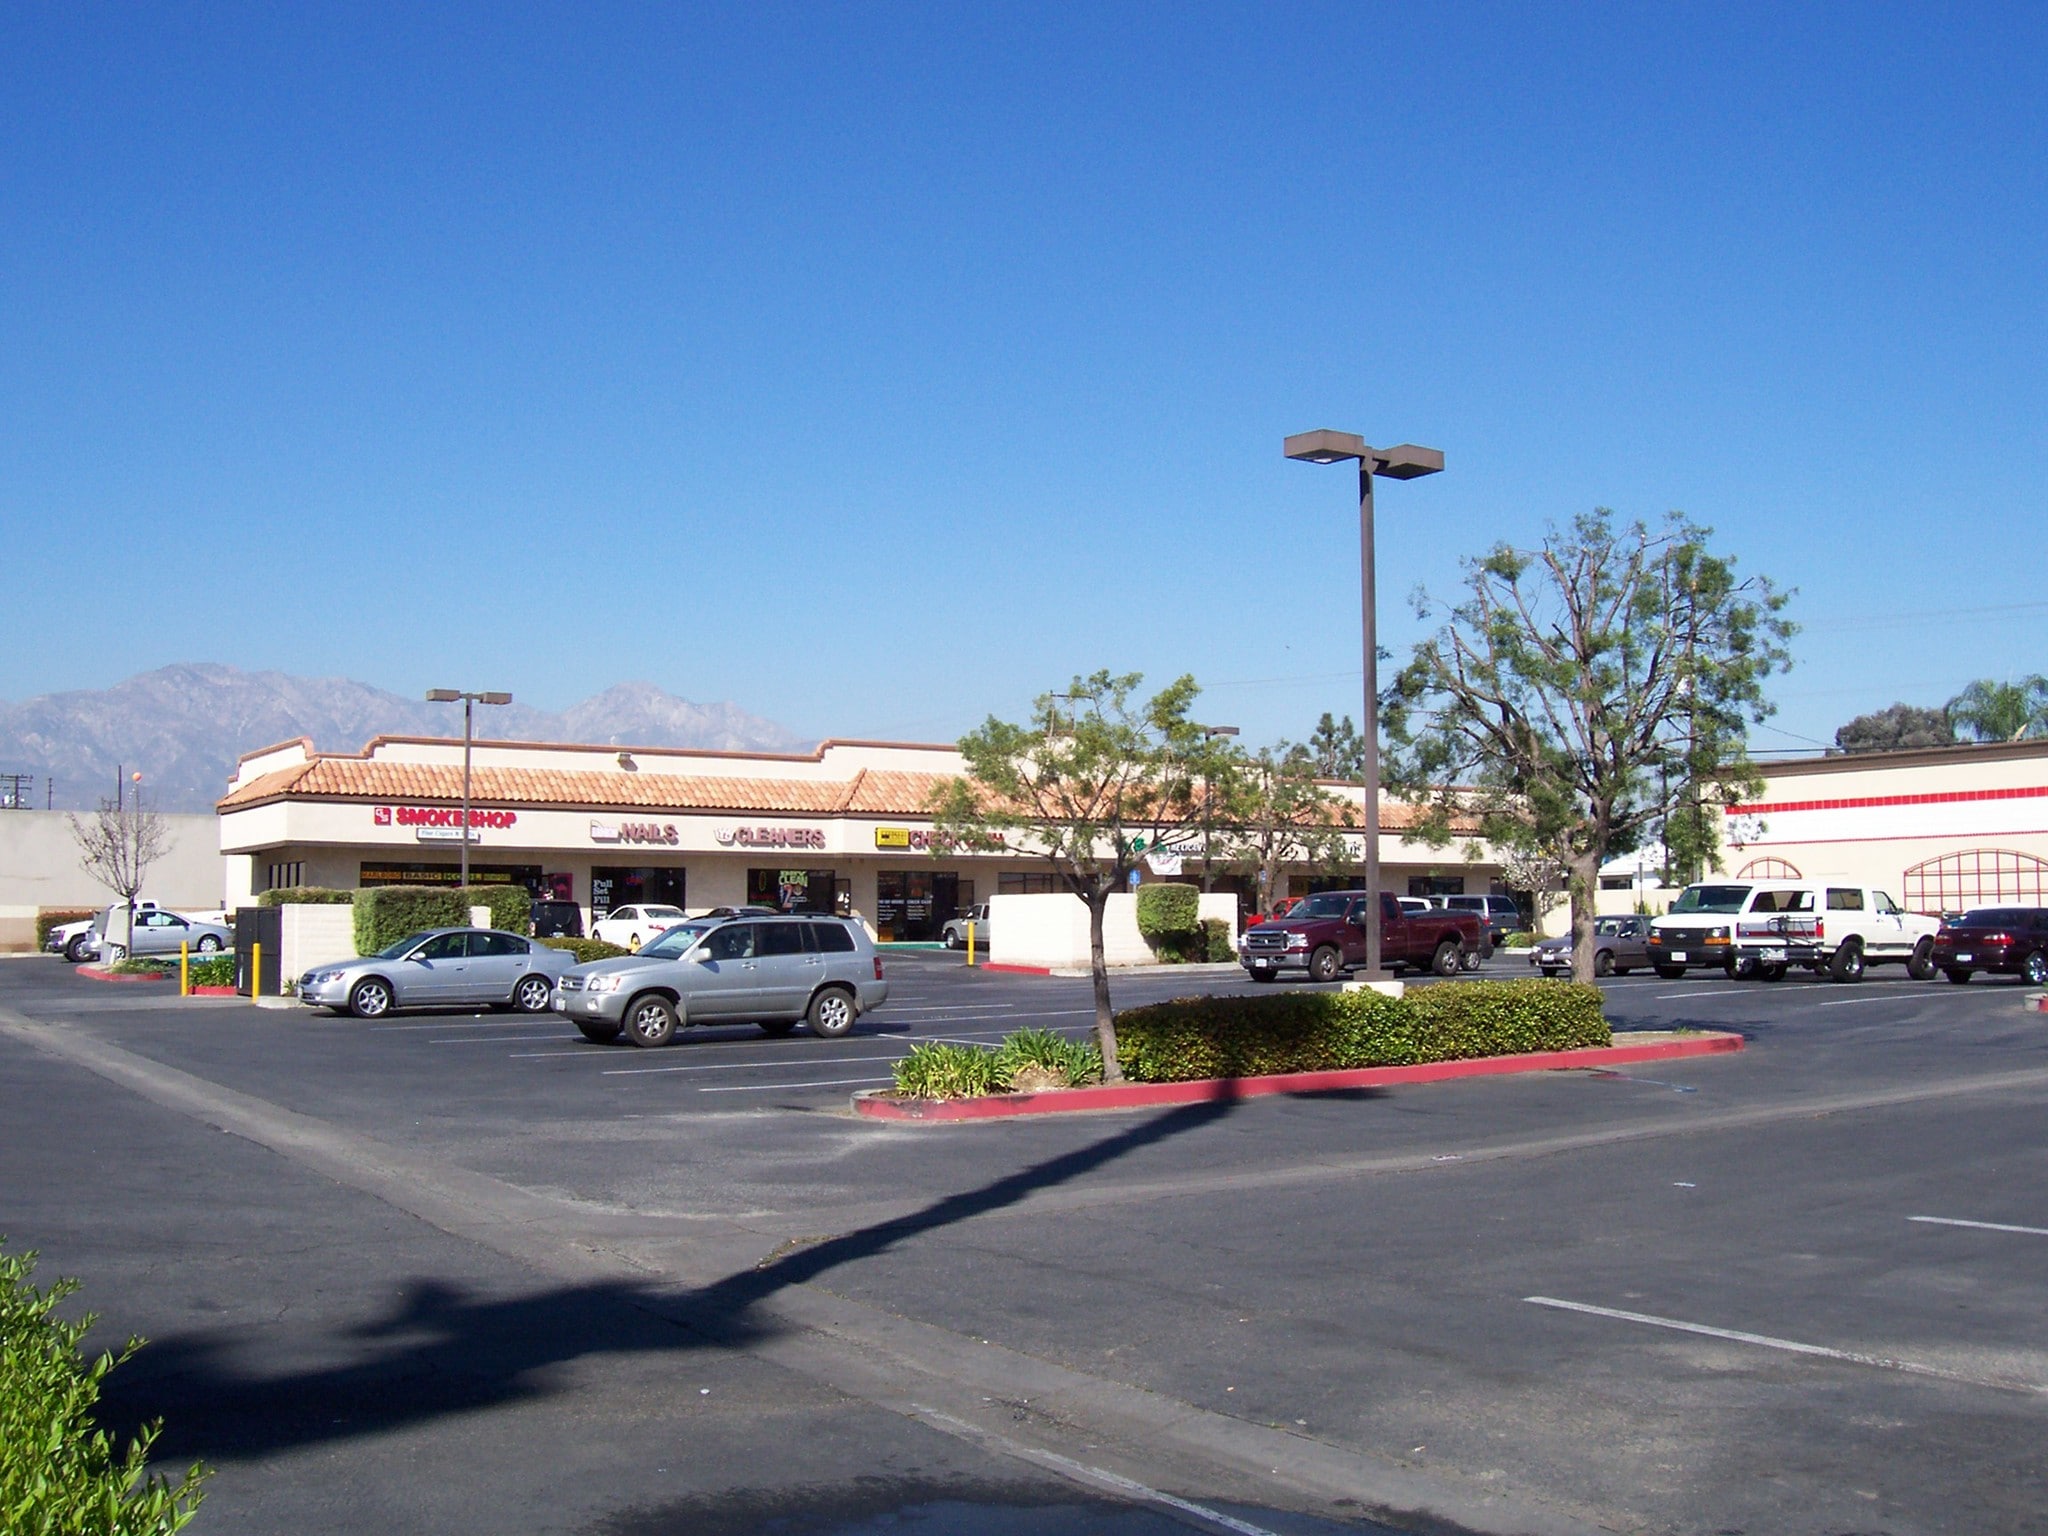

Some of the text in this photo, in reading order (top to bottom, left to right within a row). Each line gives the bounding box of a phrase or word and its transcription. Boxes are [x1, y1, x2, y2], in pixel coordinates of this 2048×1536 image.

[396, 806, 465, 827] SMOKE
[469, 808, 517, 829] SHOP
[622, 823, 679, 842] NAILS
[735, 827, 826, 848] CLEANERS
[593, 879, 613, 888] Full
[779, 875, 808, 888] CLEAN
[593, 887, 608, 895] Set
[593, 895, 611, 904] Fill
